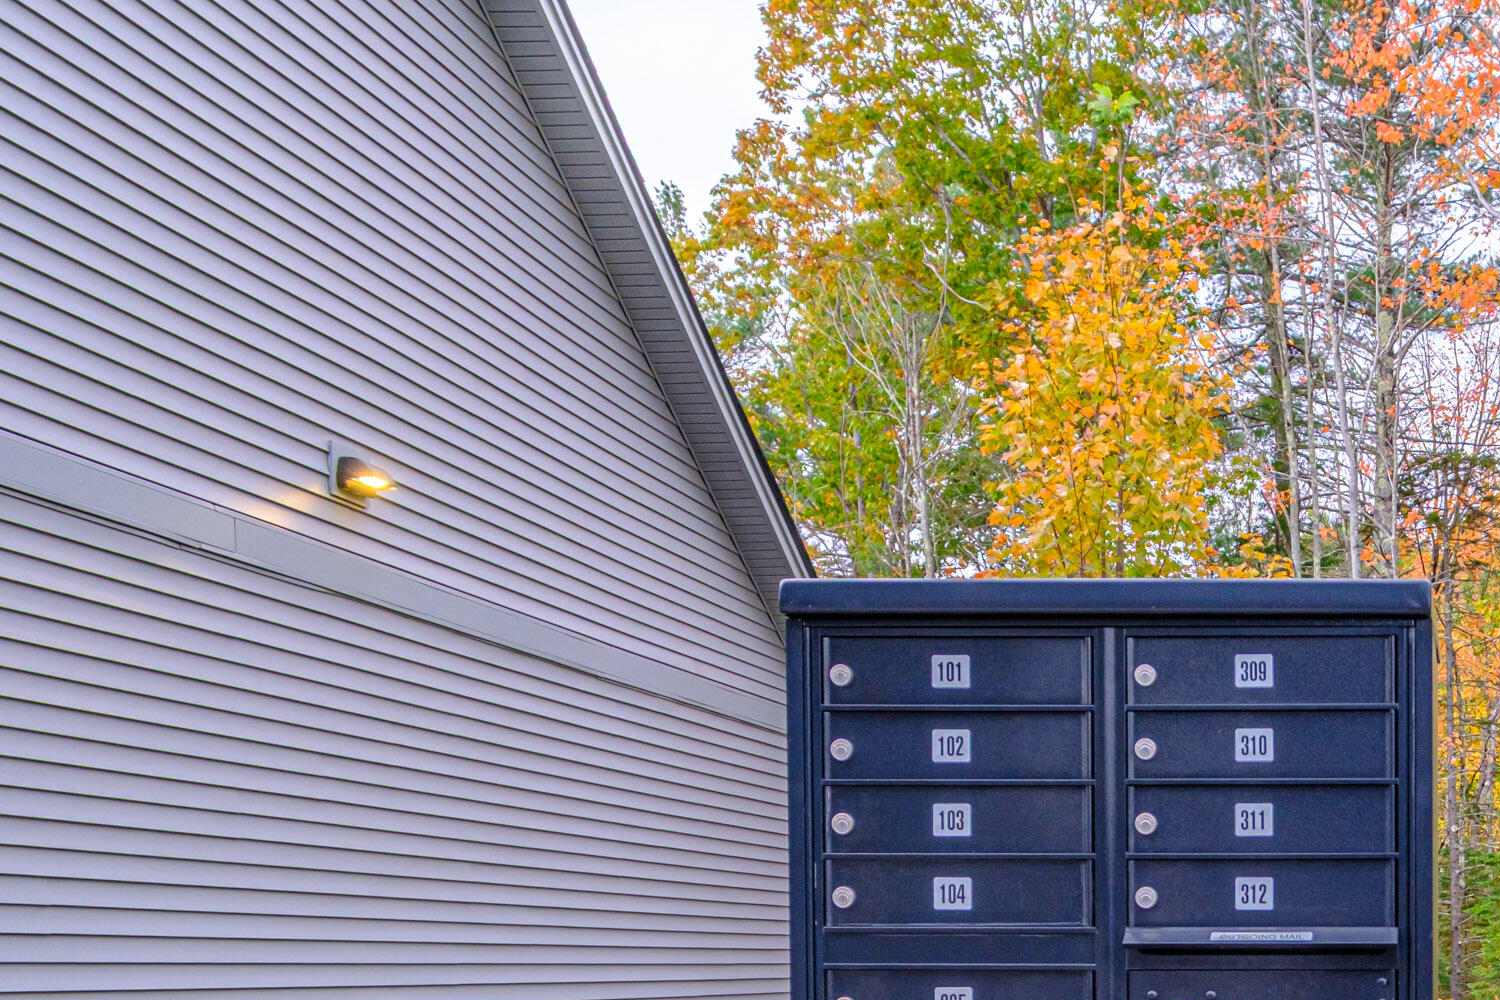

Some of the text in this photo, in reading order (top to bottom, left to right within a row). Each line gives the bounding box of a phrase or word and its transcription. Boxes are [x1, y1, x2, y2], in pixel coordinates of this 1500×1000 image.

[936, 661, 962, 682] 101
[1240, 660, 1267, 682] 309
[937, 735, 964, 757] 102
[1241, 735, 1267, 756] 310
[938, 809, 964, 831] 103
[1240, 809, 1265, 831] 311
[938, 883, 966, 904] 104
[1240, 883, 1267, 905] 312
[1219, 933, 1304, 941] OUTGOING MAIL
